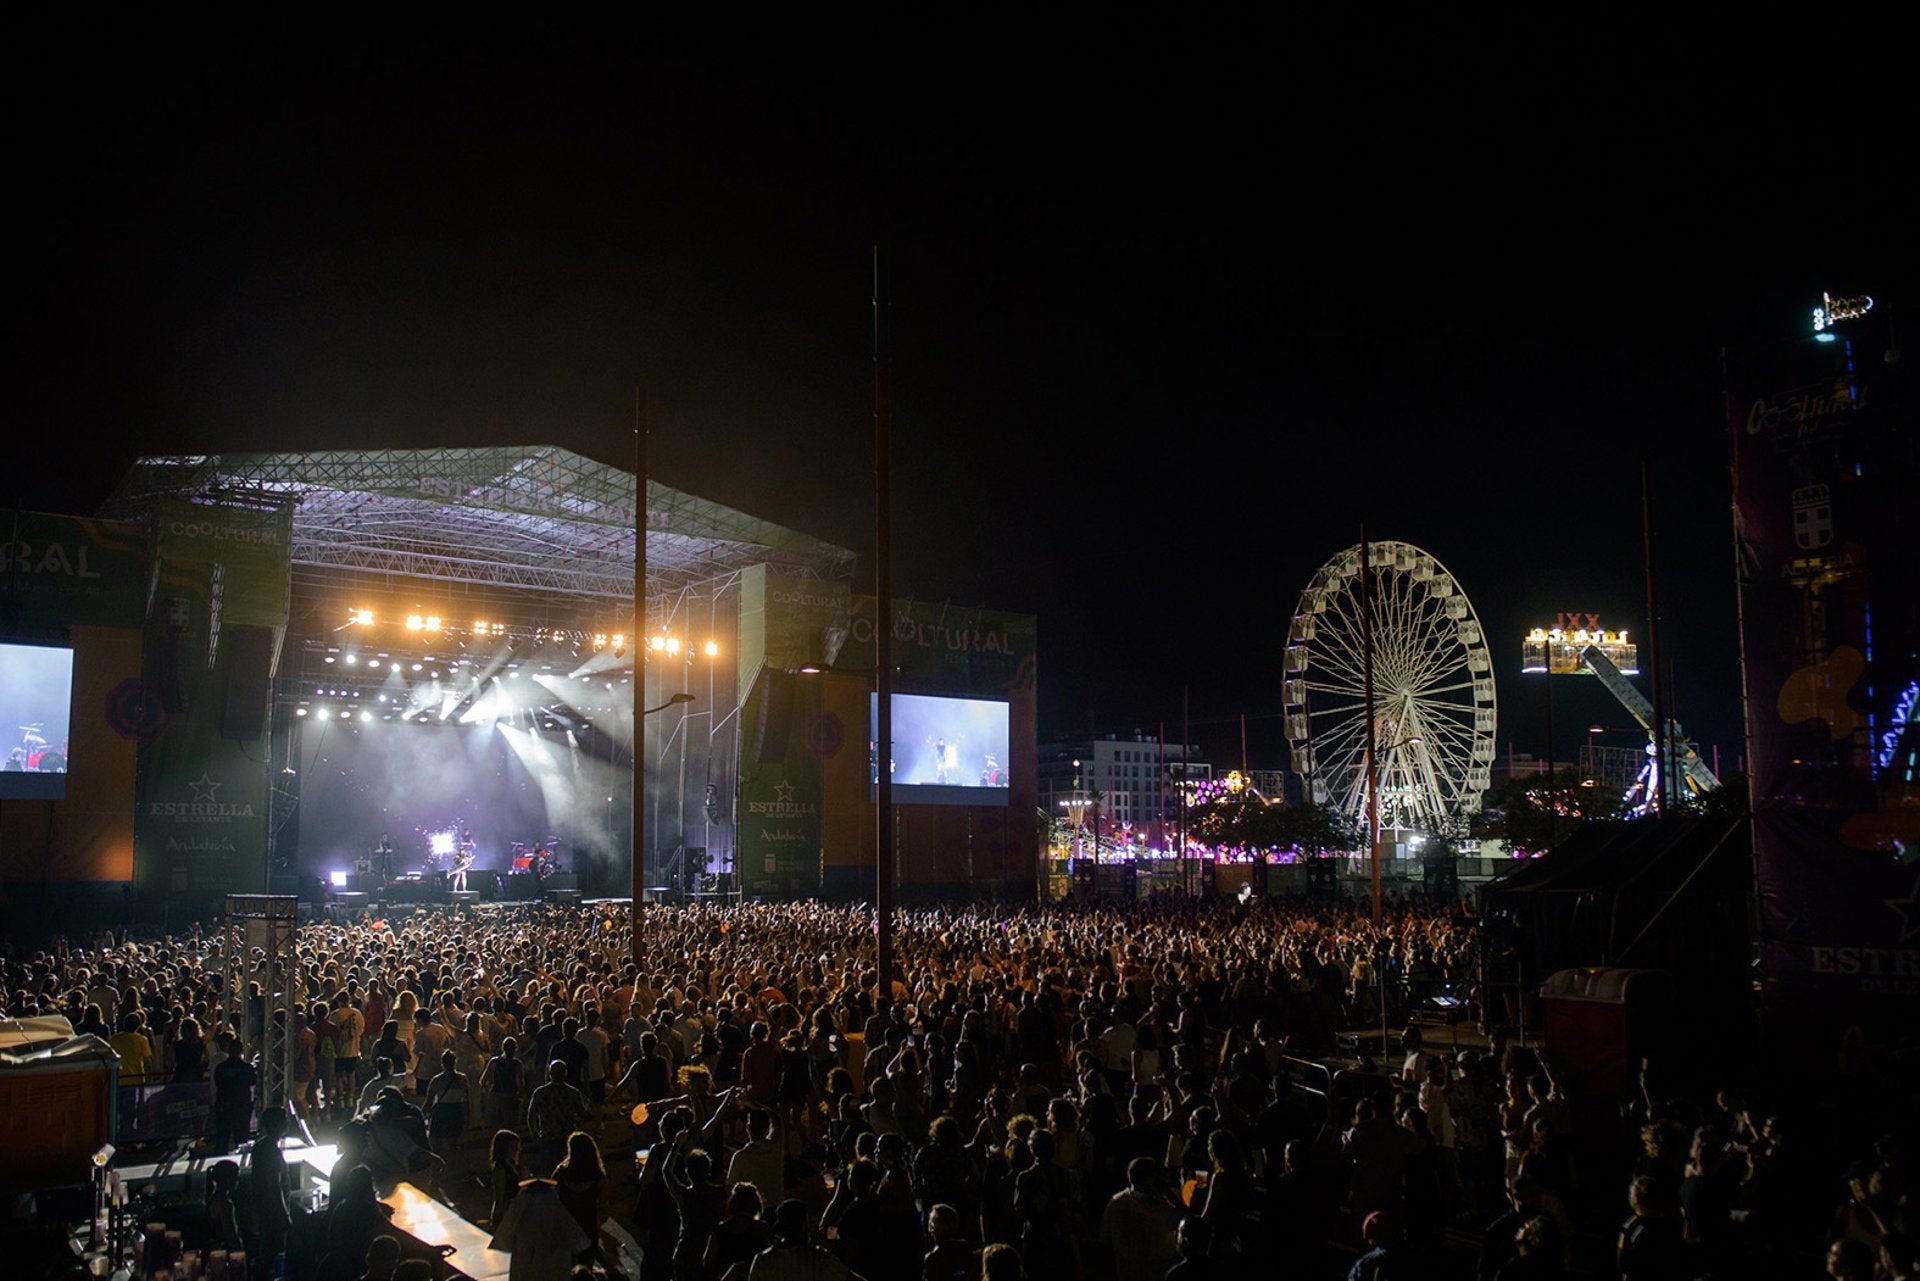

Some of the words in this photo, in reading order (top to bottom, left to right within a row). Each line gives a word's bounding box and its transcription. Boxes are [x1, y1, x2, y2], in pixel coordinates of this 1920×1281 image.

[171, 521, 281, 546] COOLTURAL
[852, 617, 1015, 656] COLTURAL
[150, 801, 254, 817] ESTRELLA
[748, 802, 816, 813] ESTRELLA
